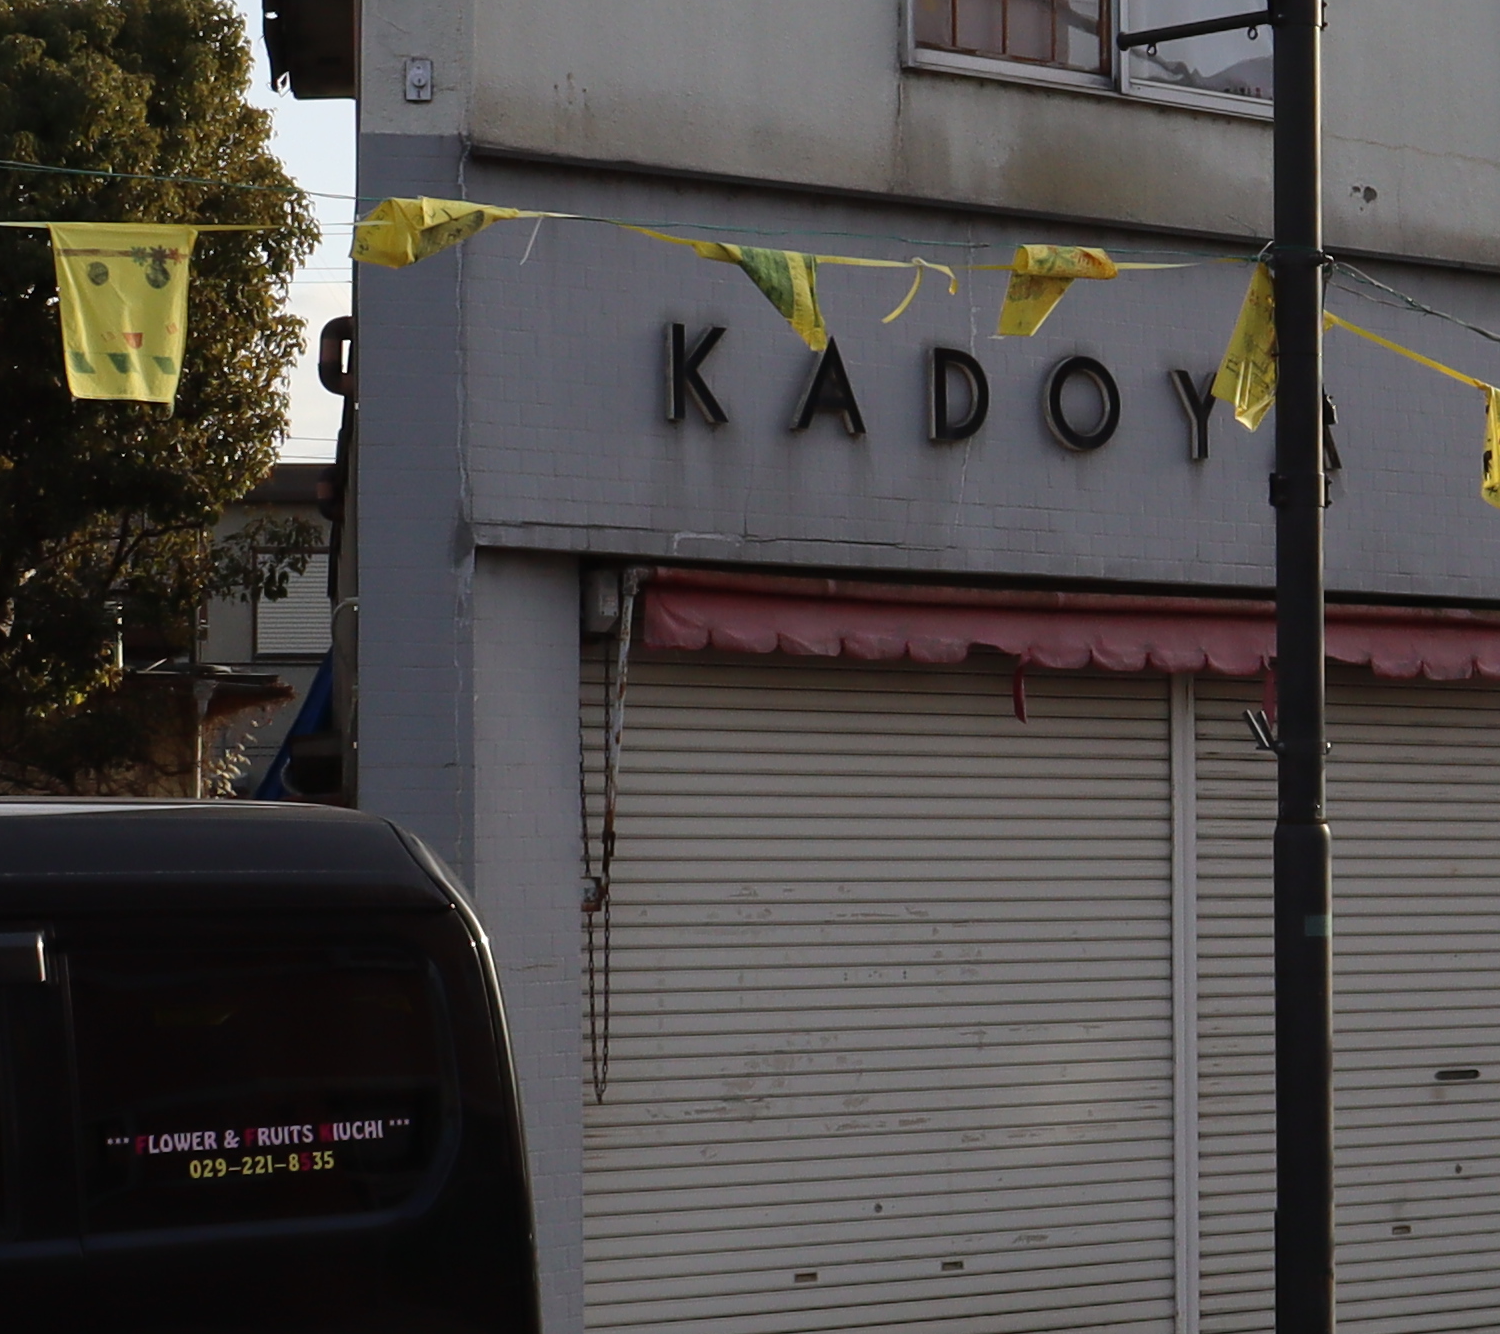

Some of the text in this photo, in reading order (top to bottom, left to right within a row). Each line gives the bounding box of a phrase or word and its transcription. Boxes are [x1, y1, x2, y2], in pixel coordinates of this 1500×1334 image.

[664, 321, 1343, 471] KADOY
[134, 1119, 384, 1155] FLOWER & FRUITS KIUCHI
[189, 1150, 335, 1179] 029-221-8535
